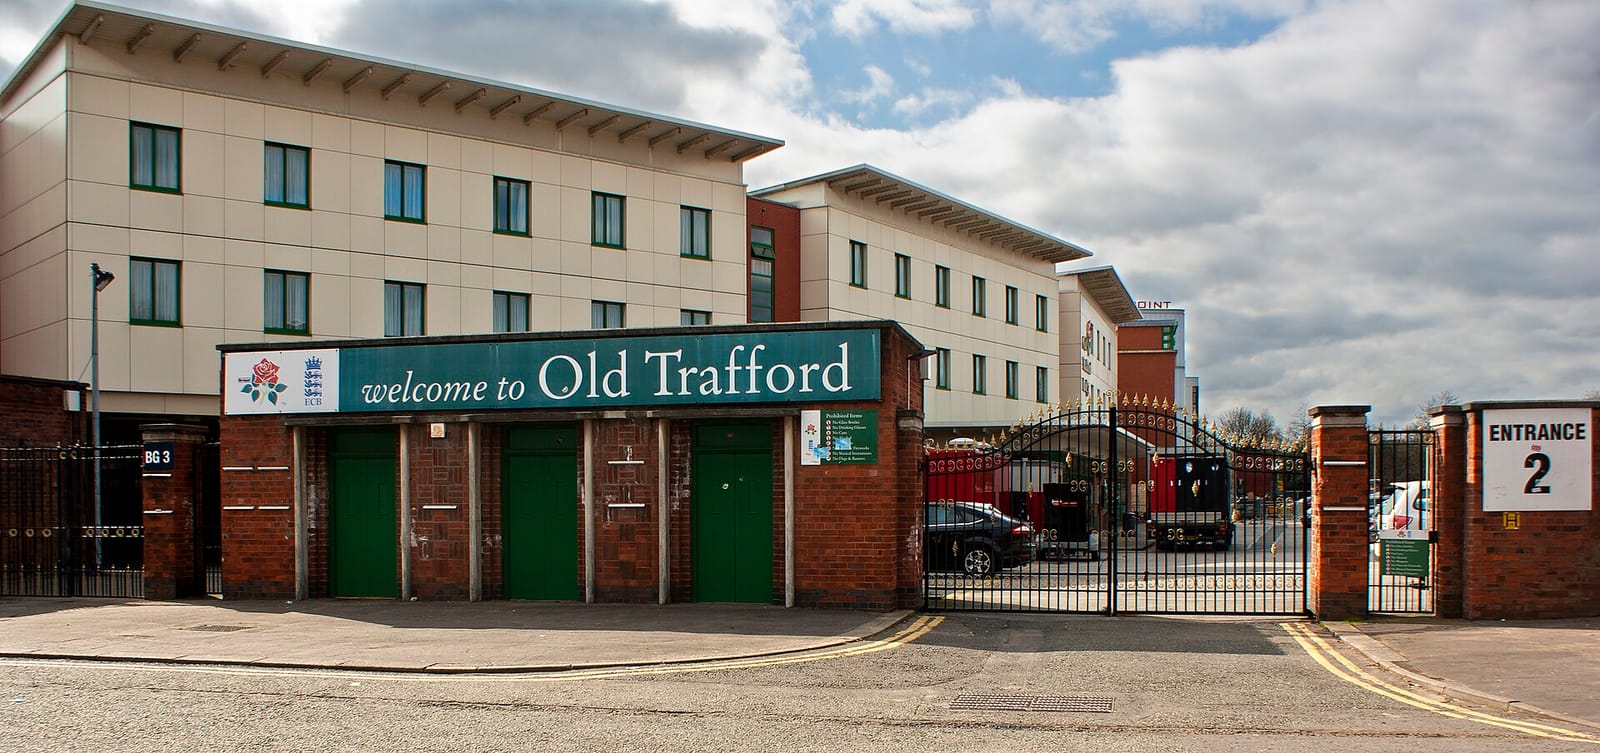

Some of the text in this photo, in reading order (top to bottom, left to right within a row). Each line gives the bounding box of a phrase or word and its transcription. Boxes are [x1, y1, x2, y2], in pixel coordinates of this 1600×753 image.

[362, 342, 853, 404] welcome to Old Trafford
[304, 398, 322, 406] ECB
[1489, 423, 1586, 442] ENTRANCE
[145, 450, 170, 464] BG 3
[1523, 453, 1551, 494] 2
